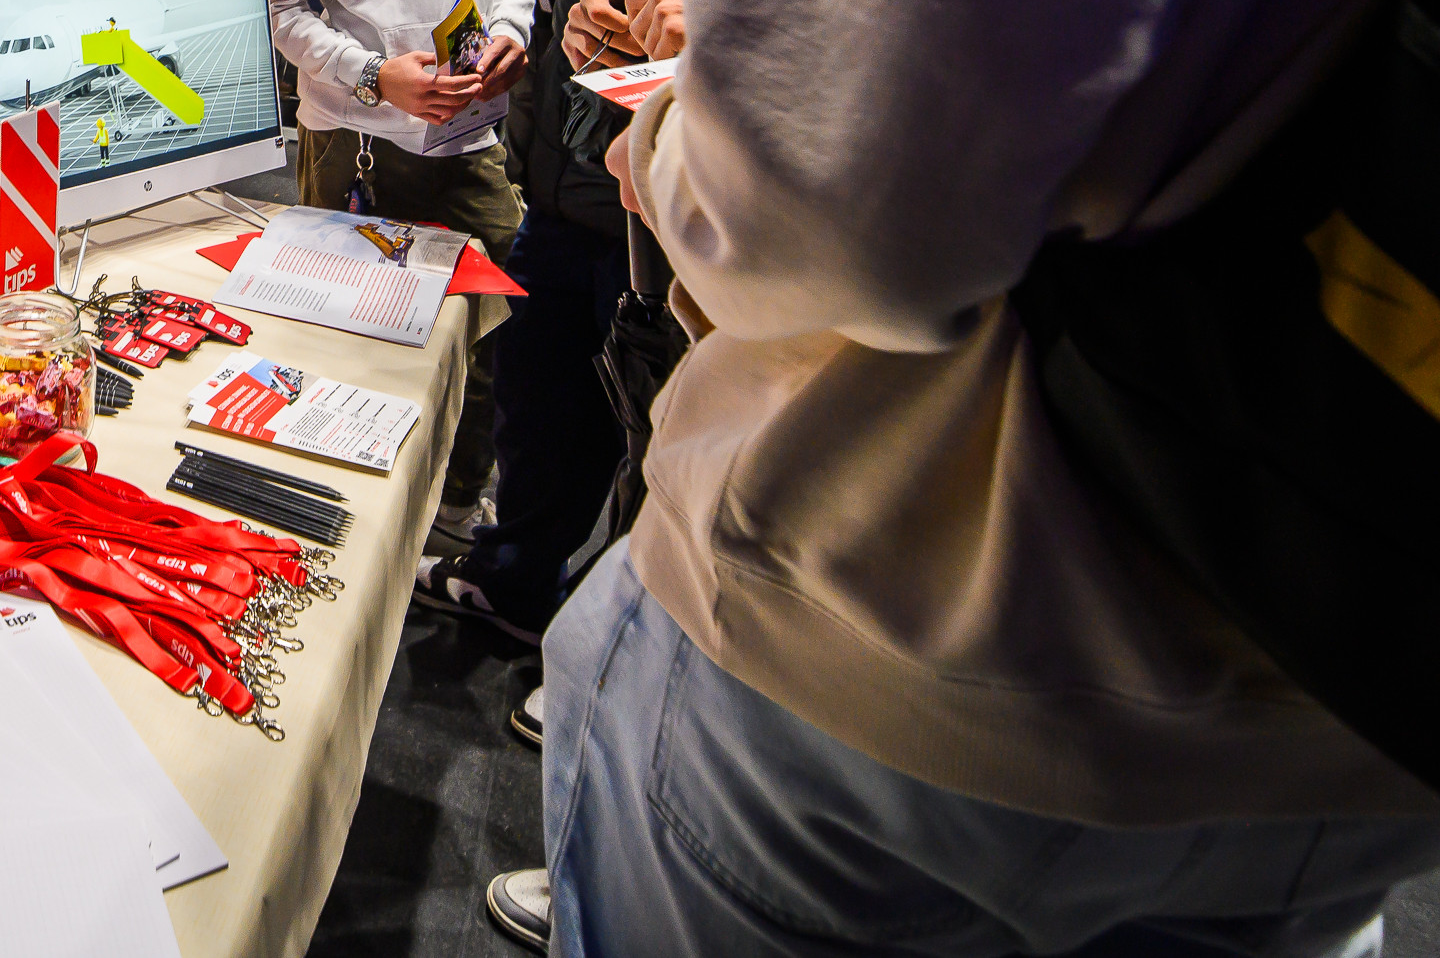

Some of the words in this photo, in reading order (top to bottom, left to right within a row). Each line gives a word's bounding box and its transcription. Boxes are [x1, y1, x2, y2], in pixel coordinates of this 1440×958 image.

[3, 263, 37, 294] tips
[156, 555, 187, 572] tips
[4, 611, 37, 628] tips
[171, 638, 195, 668] tips
